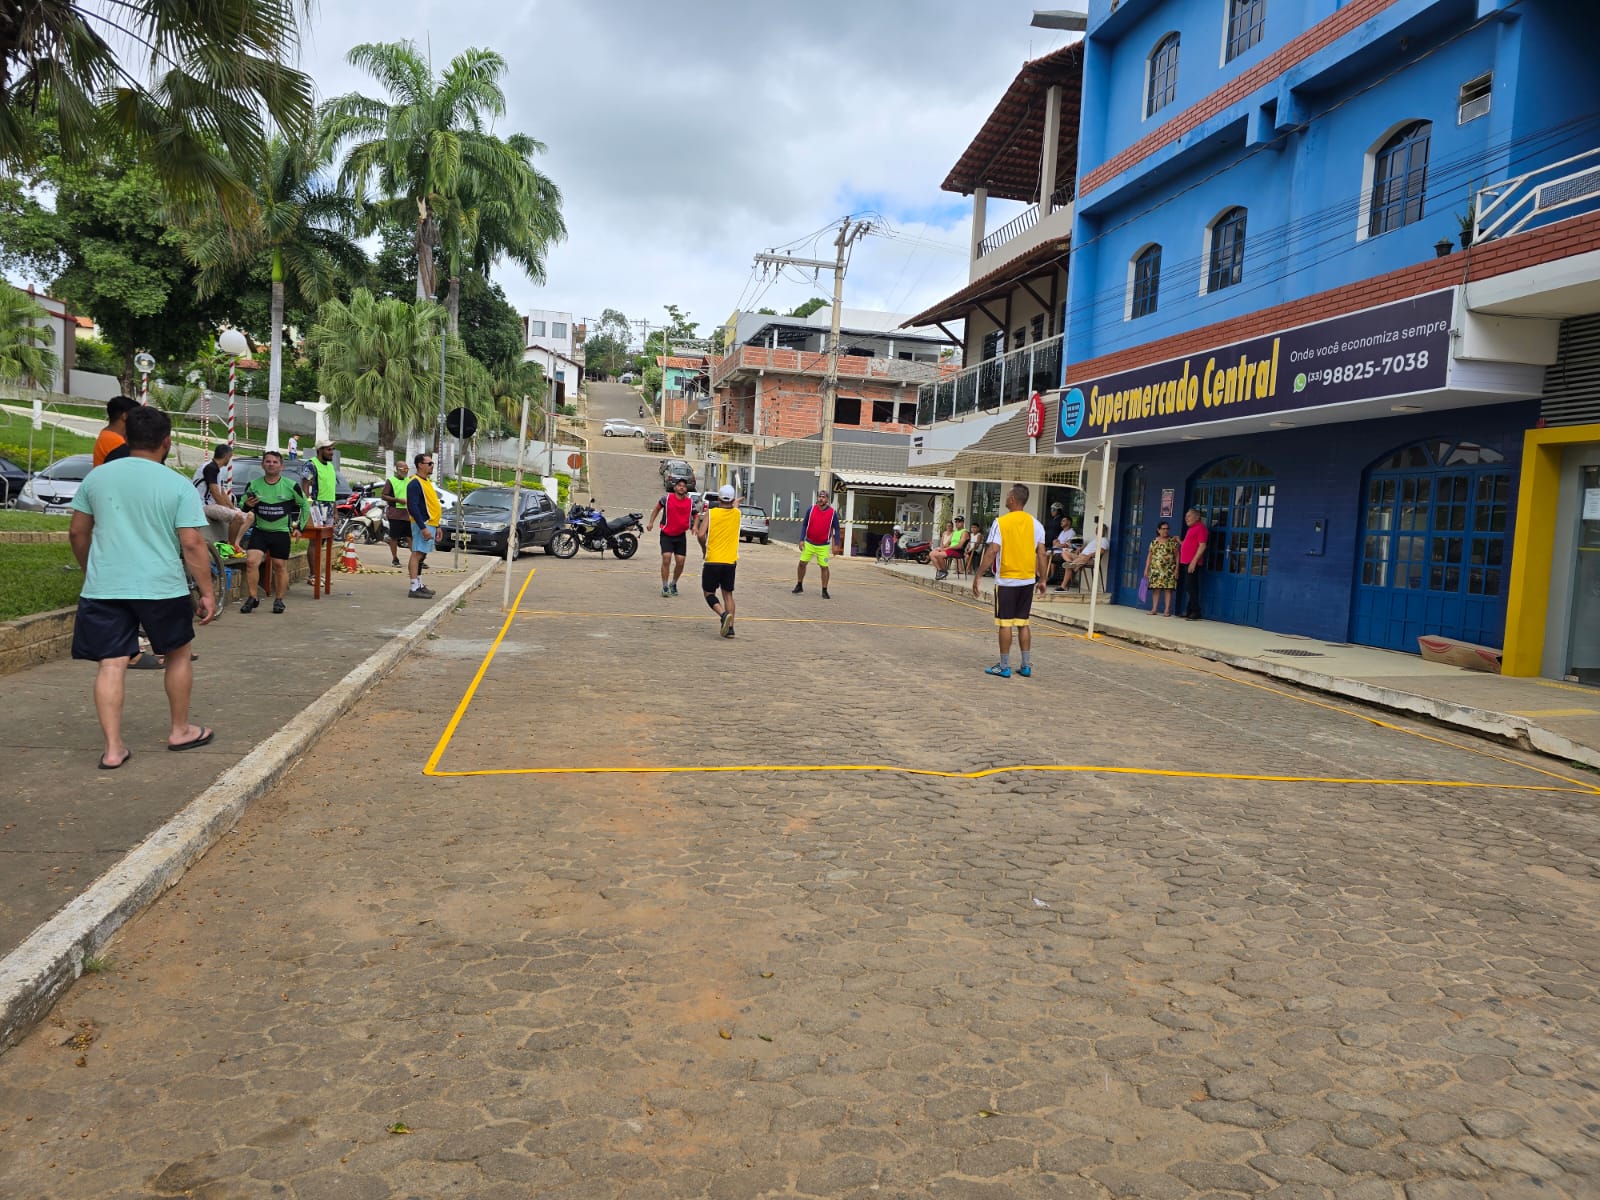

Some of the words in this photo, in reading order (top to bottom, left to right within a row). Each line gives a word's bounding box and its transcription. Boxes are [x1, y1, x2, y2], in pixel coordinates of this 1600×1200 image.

[1290, 348, 1315, 363] Onde
[1316, 341, 1339, 357] você
[1341, 331, 1399, 352] economiza
[1401, 320, 1447, 337] sempre
[1088, 360, 1199, 434] Supermercado
[1202, 337, 1280, 408] Central
